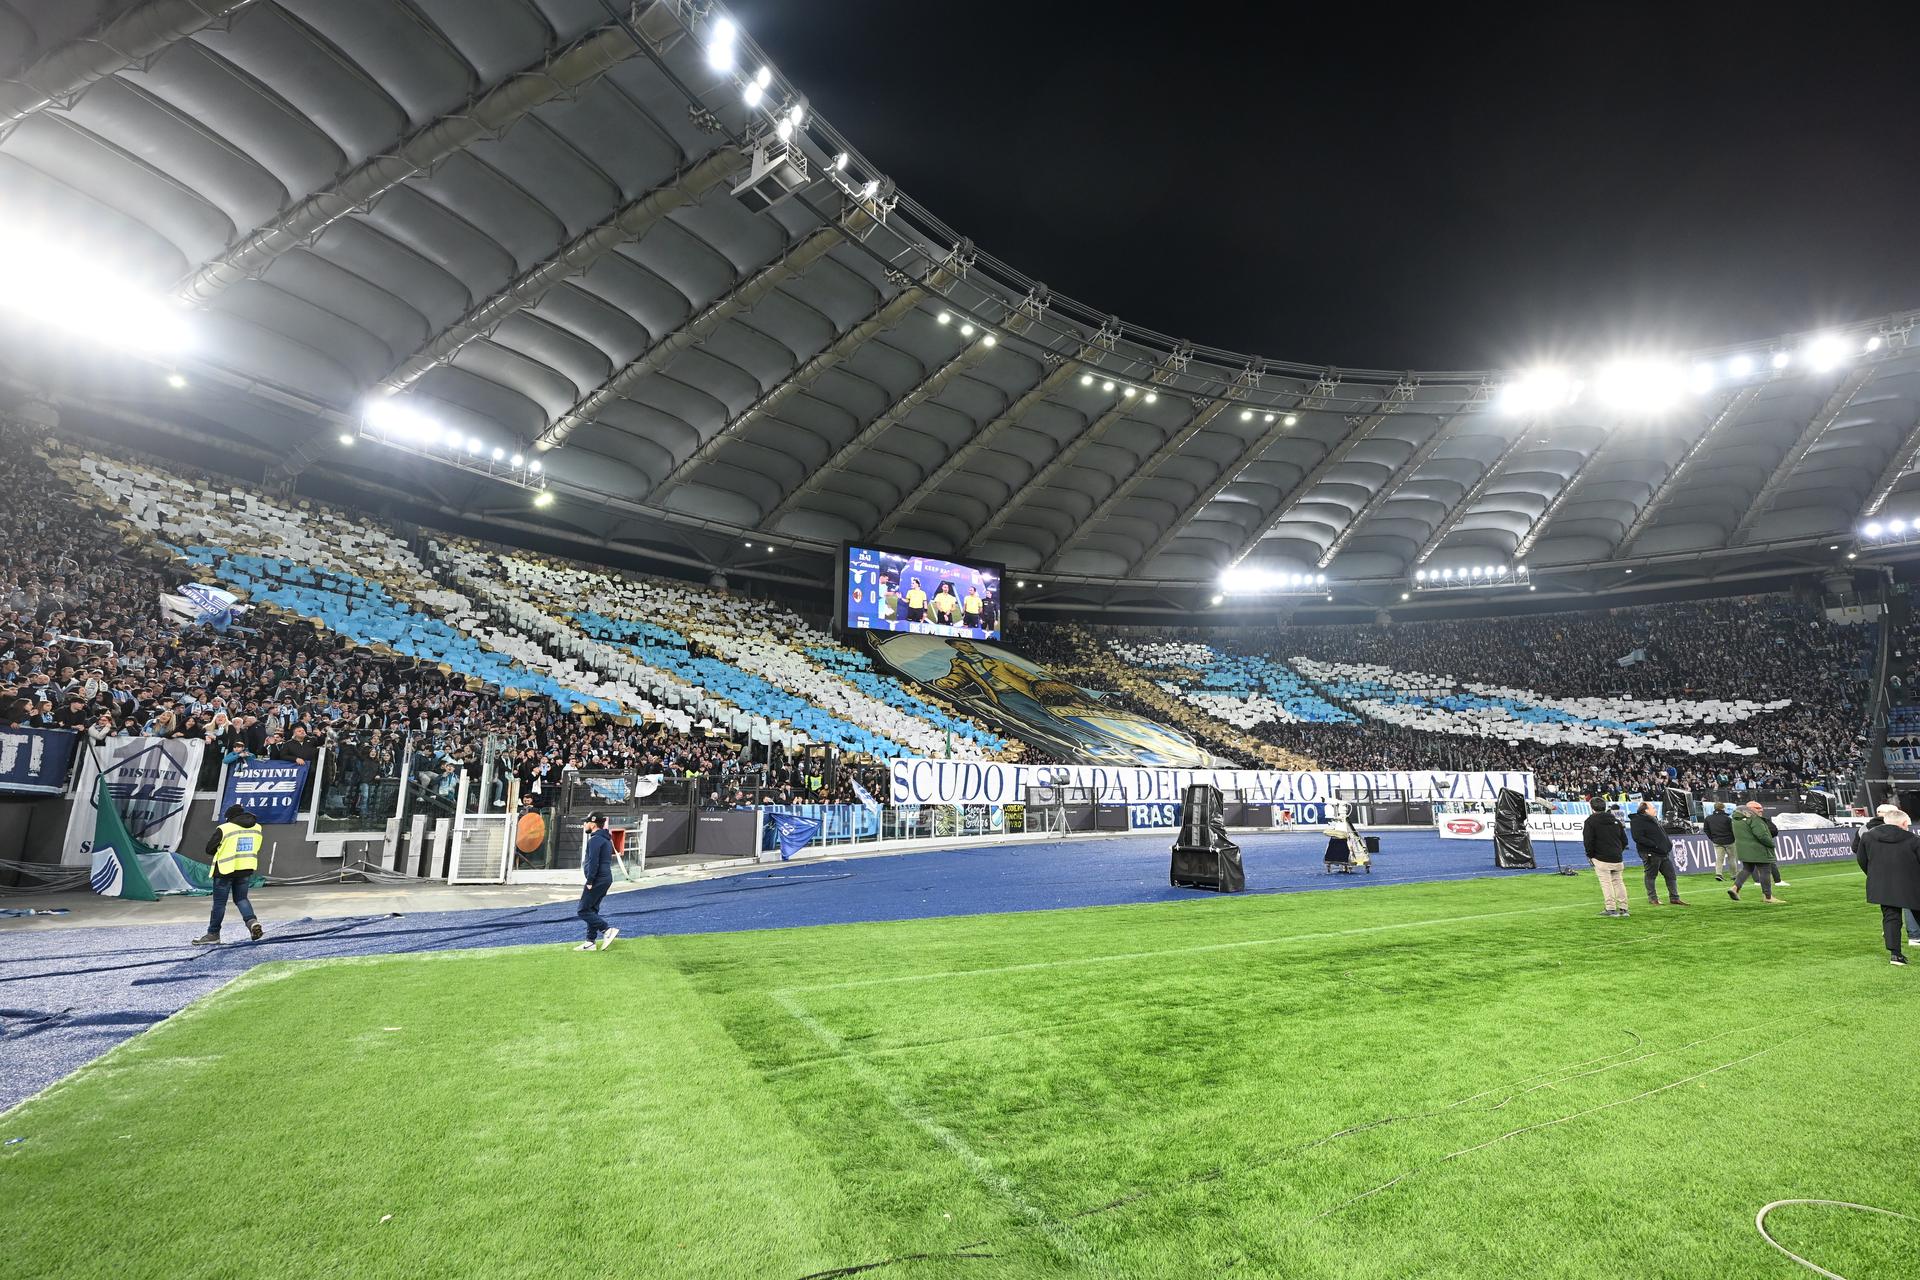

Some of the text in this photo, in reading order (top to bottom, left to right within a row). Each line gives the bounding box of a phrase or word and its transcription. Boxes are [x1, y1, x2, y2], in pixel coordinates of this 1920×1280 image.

[870, 571, 877, 585] 0
[870, 590, 876, 604] 0
[239, 768, 298, 779] DISTINTI
[893, 760, 1004, 803] SCUDO
[1013, 766, 1030, 802] E
[1036, 767, 1128, 801] SPADA
[1231, 772, 1318, 801] LAZIO
[1350, 773, 1402, 801] DEI
[235, 796, 292, 807] LAZIO
[1806, 832, 1851, 845] CLINICA PRIVATA
[1809, 845, 1853, 858] POLISPECIALISTICA
